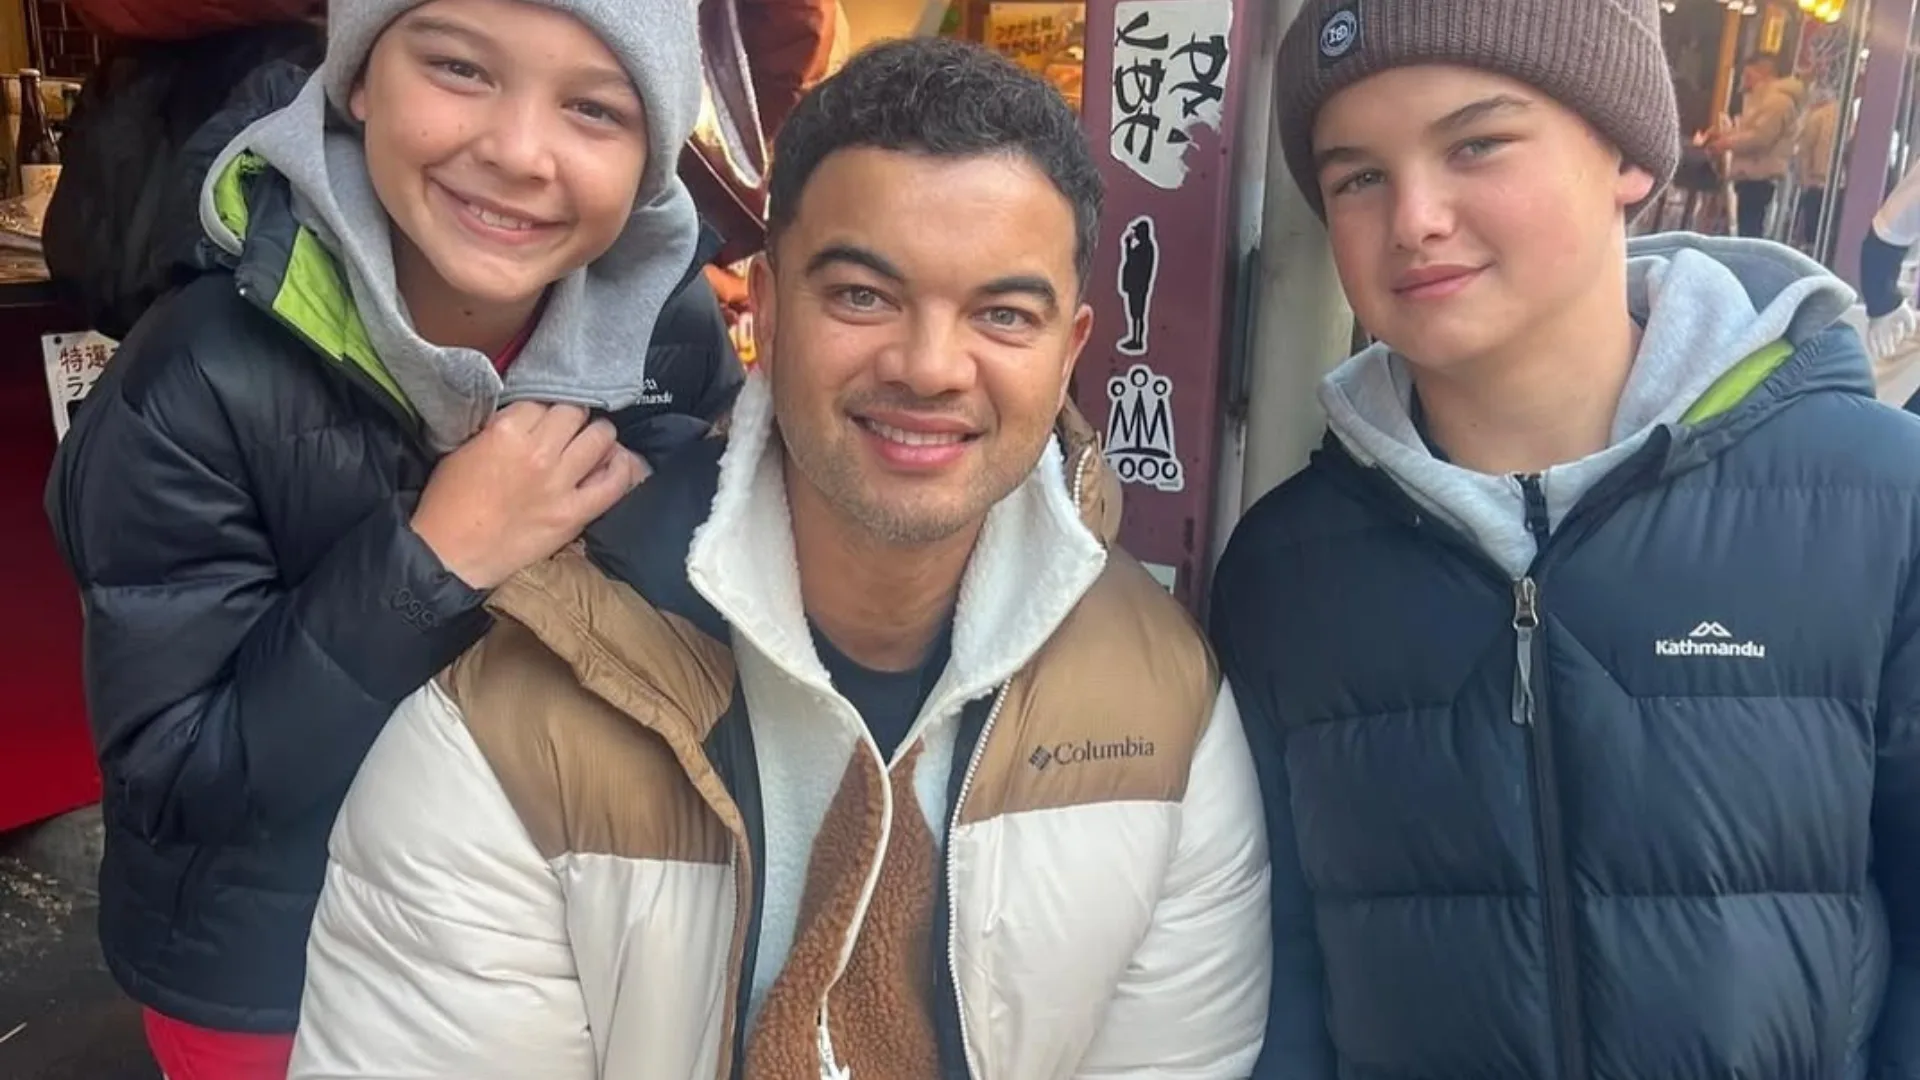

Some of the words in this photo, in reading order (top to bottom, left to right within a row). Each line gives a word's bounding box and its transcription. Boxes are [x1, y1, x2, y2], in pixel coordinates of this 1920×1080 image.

[60, 344, 117, 374] 特選
[1655, 639, 1766, 658] Kathmandu
[1053, 735, 1155, 766] Columbia
